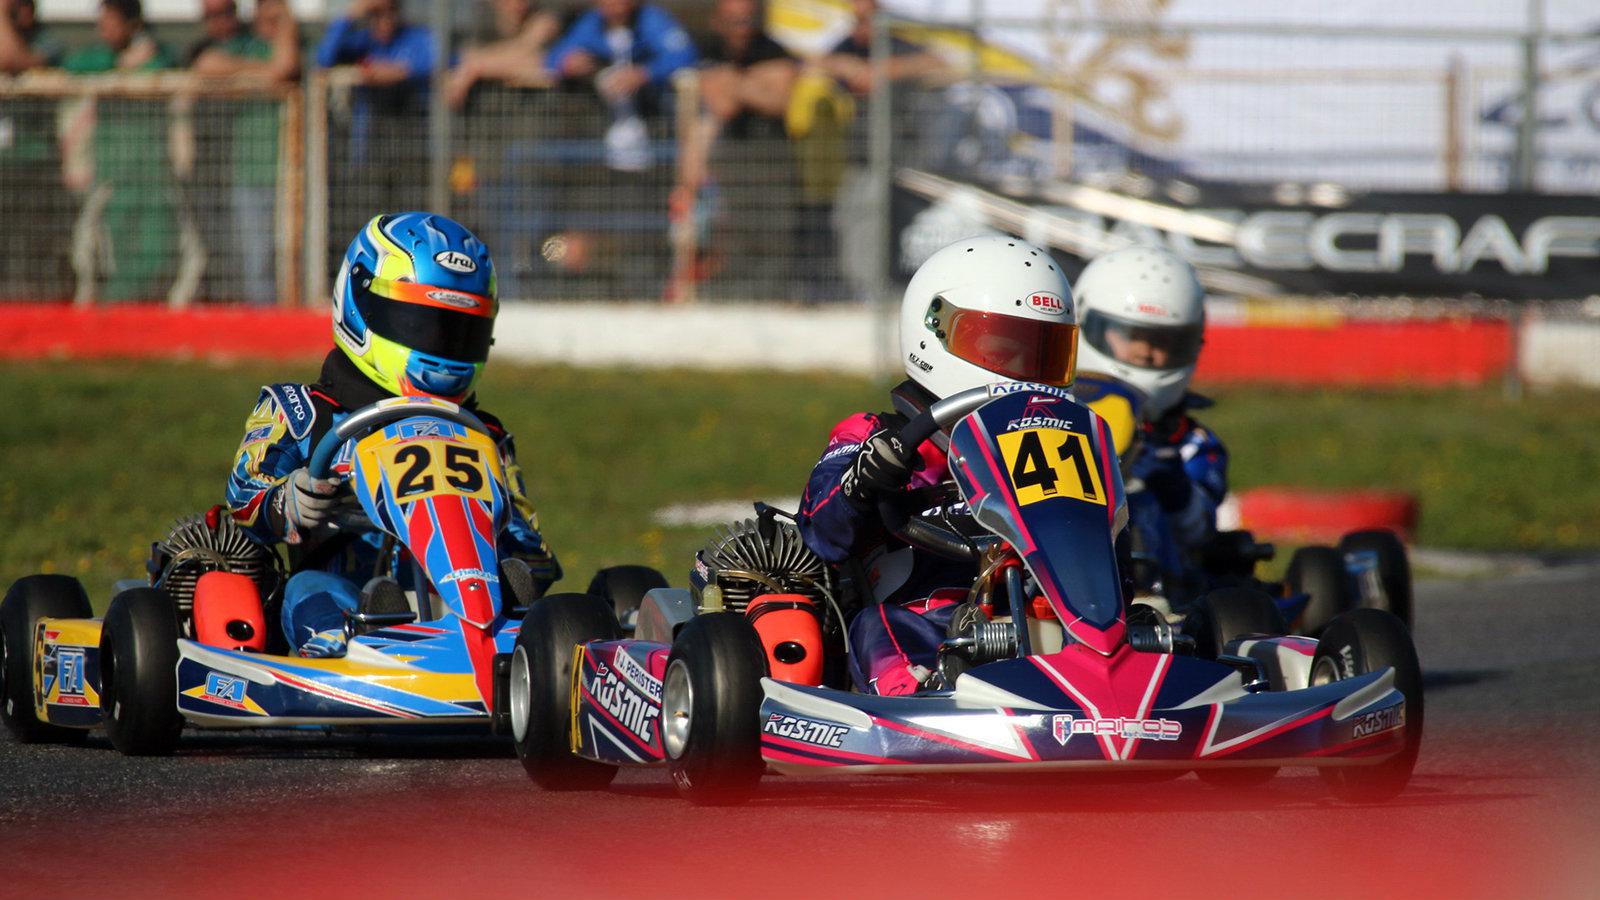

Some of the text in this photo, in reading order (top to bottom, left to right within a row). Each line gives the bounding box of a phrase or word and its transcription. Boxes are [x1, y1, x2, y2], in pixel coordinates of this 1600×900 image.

[437, 252, 473, 269] Arai
[1032, 295, 1063, 309] BELL
[394, 444, 484, 499] 25
[1012, 431, 1097, 500] 41
[206, 672, 247, 702] FA
[591, 662, 660, 742] KOSMIC
[763, 713, 849, 747] KOSMIC
